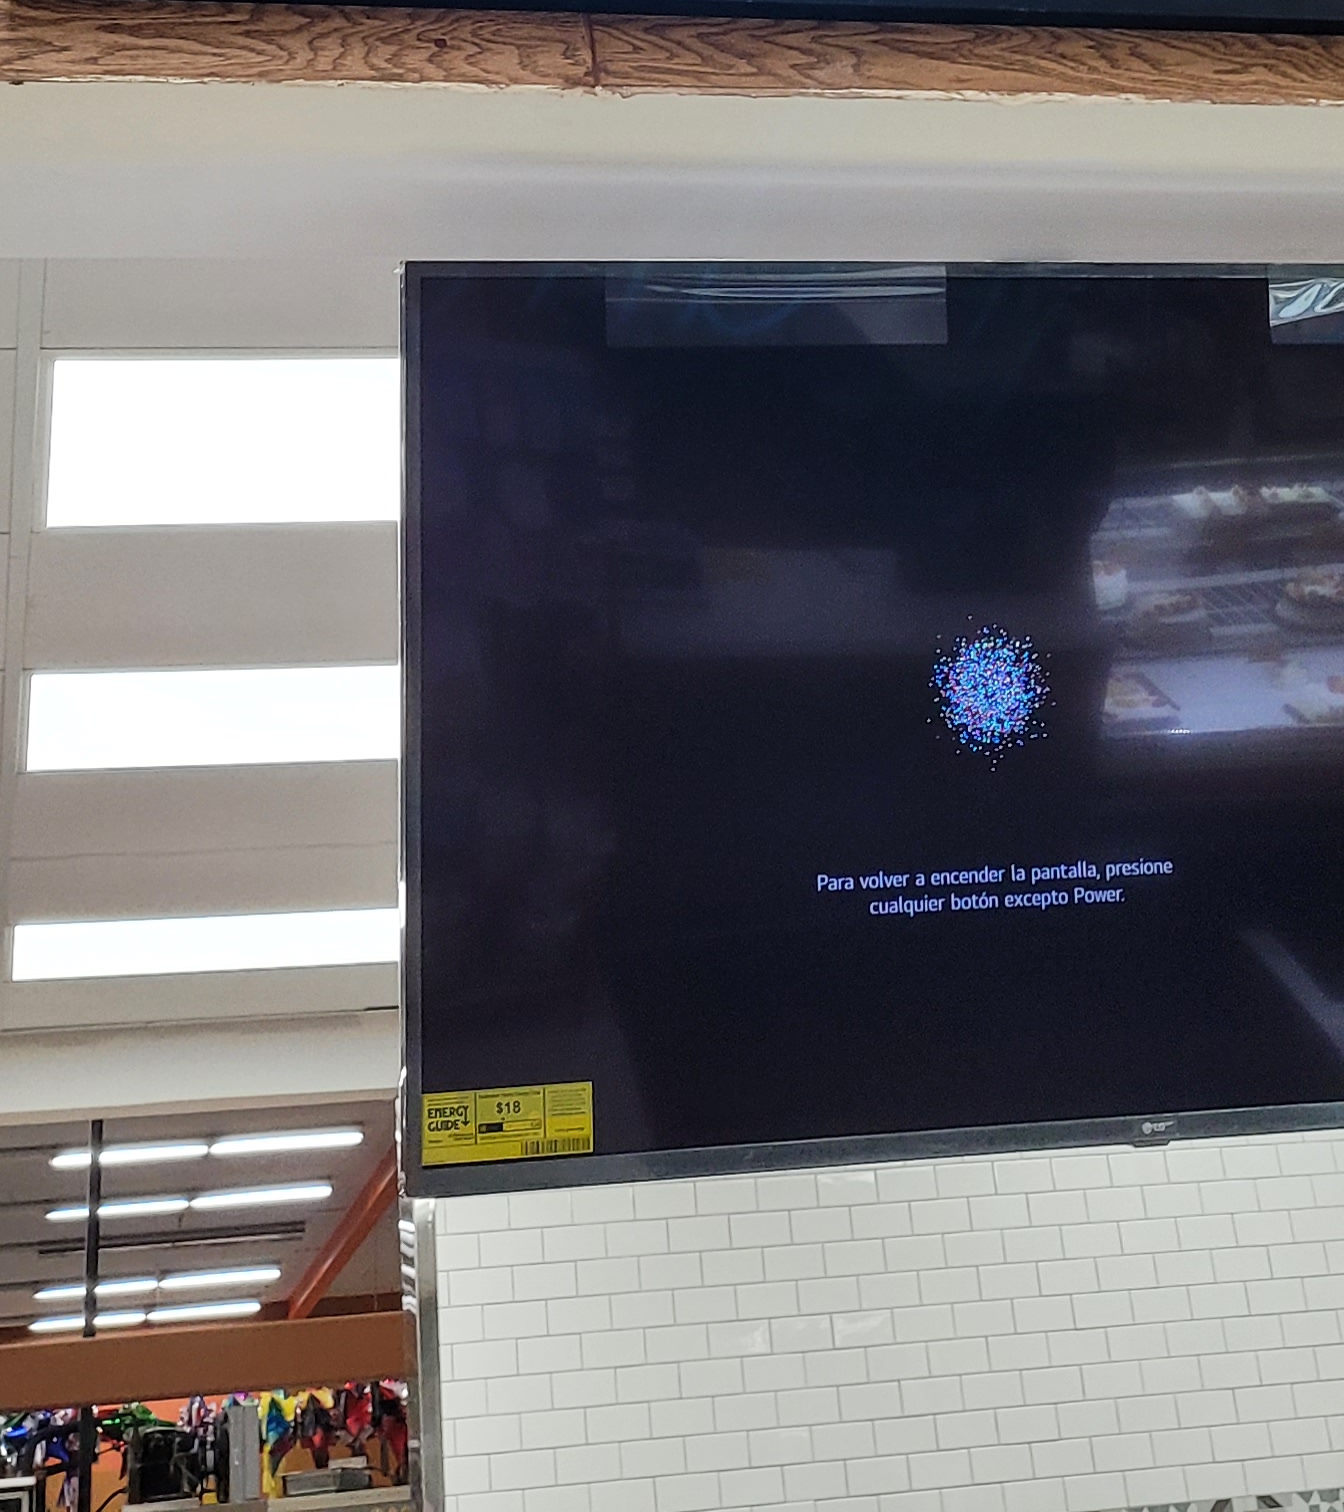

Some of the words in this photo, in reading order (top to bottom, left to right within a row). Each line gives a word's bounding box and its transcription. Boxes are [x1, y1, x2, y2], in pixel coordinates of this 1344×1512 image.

[817, 874, 854, 892] Para
[859, 870, 910, 889] volver
[915, 873, 926, 887] a
[930, 865, 1005, 886] encender
[1011, 863, 1026, 882] la
[1031, 860, 1101, 885] pantalla,
[1106, 858, 1173, 882] presione
[869, 894, 945, 917] cualquier
[950, 891, 999, 911] botón
[1004, 890, 1069, 910] excepto
[1073, 887, 1126, 904] Power.
[427, 1104, 469, 1119] ENERGY
[496, 1099, 521, 1115] $18
[427, 1119, 461, 1132] GUIDE
